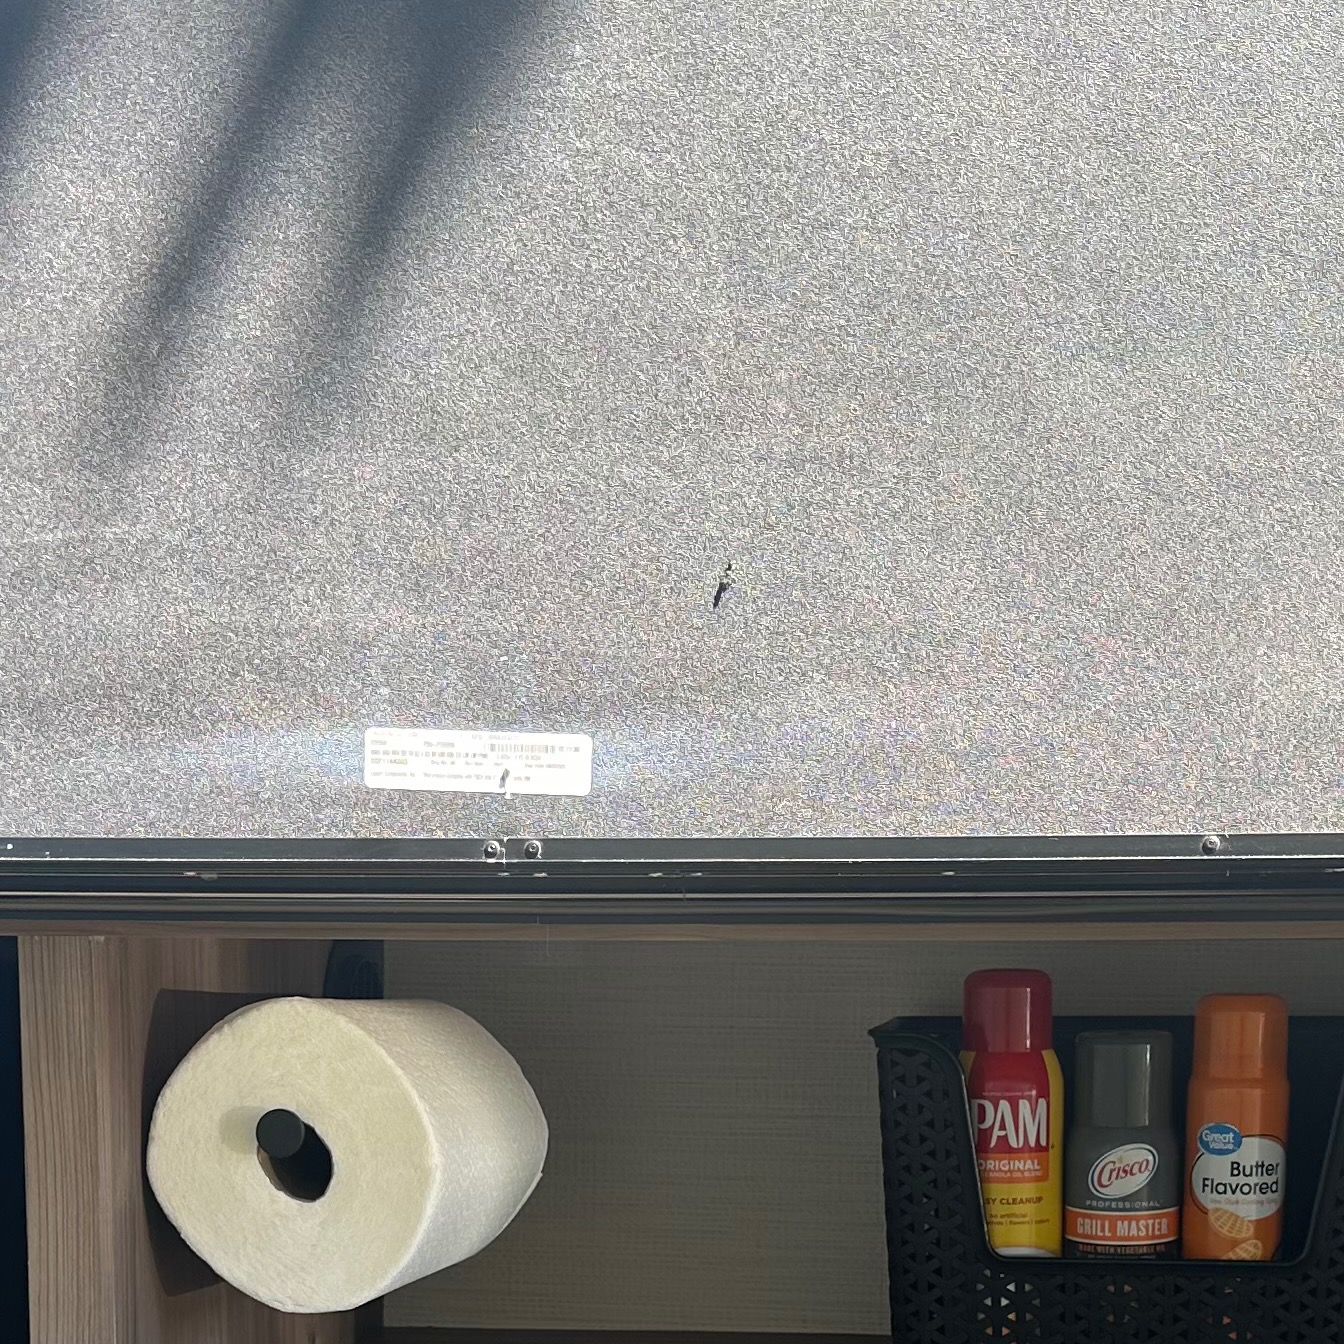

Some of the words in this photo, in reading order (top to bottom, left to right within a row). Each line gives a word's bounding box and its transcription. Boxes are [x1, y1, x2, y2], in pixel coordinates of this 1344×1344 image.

[970, 1098, 1047, 1149] PAM
[1202, 1130, 1235, 1143] Great
[978, 1158, 1041, 1171] ORIGINAL
[1230, 1161, 1280, 1177] Butter
[1097, 1158, 1151, 1189] Crisco
[1201, 1178, 1279, 1195] Flavored
[1085, 1200, 1160, 1209] PROFESSIONAL
[1077, 1217, 1112, 1237] GRILL
[1117, 1218, 1168, 1237] MASTER
